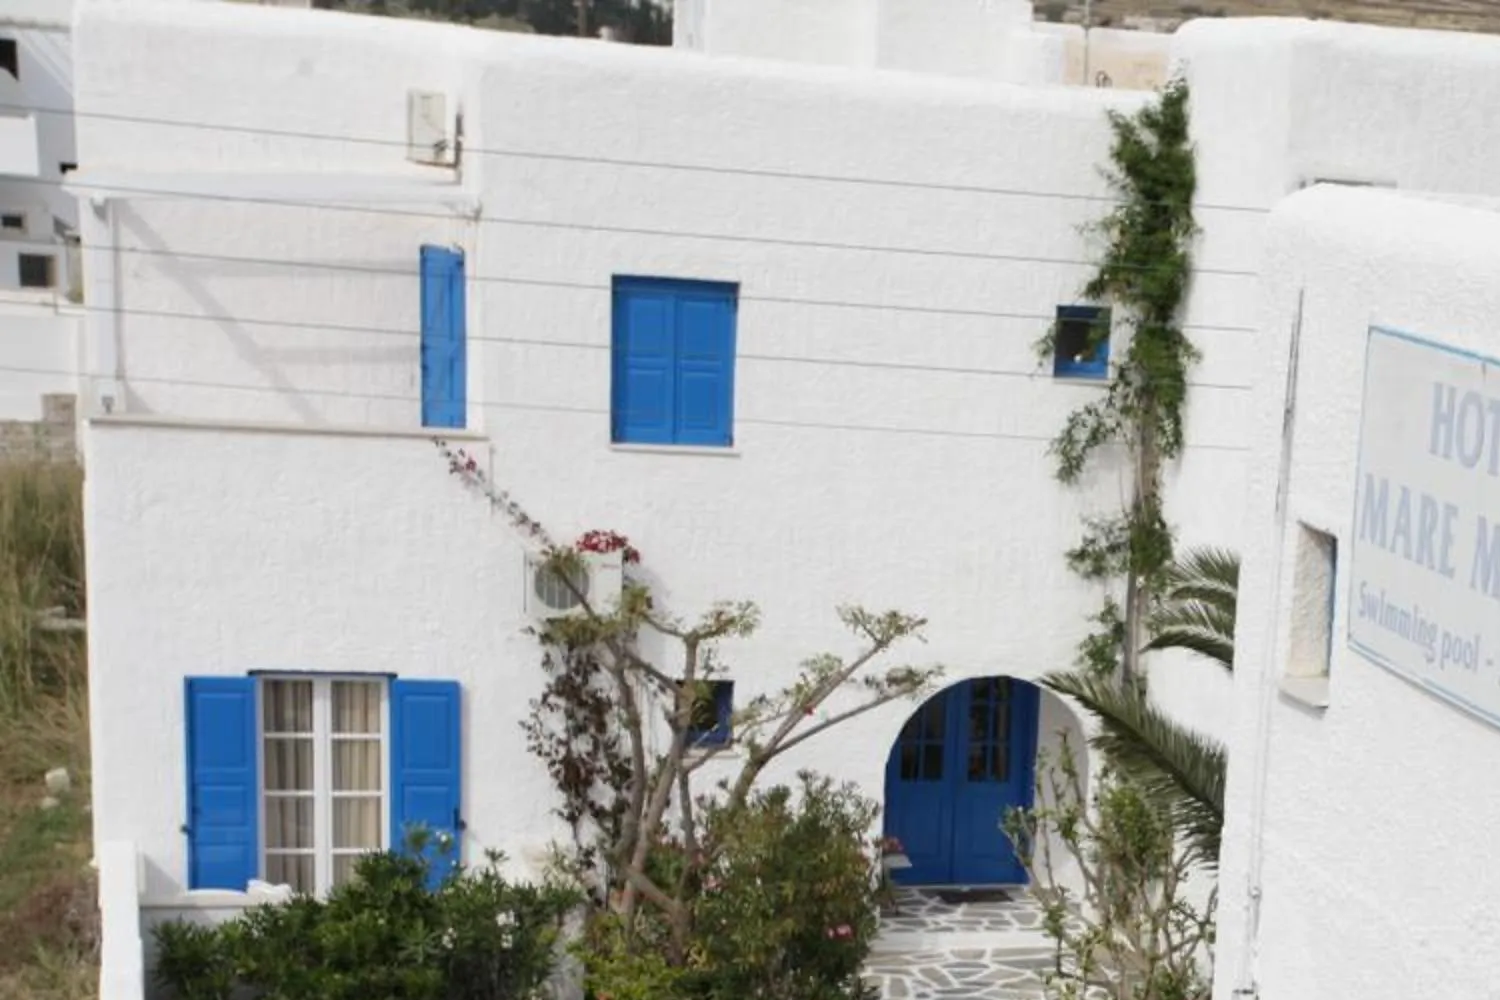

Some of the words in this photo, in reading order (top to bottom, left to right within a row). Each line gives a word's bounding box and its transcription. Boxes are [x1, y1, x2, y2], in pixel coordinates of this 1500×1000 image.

[1359, 473, 1459, 579] MARE
[1359, 581, 1437, 663] Swimming
[1439, 632, 1480, 671] pool
